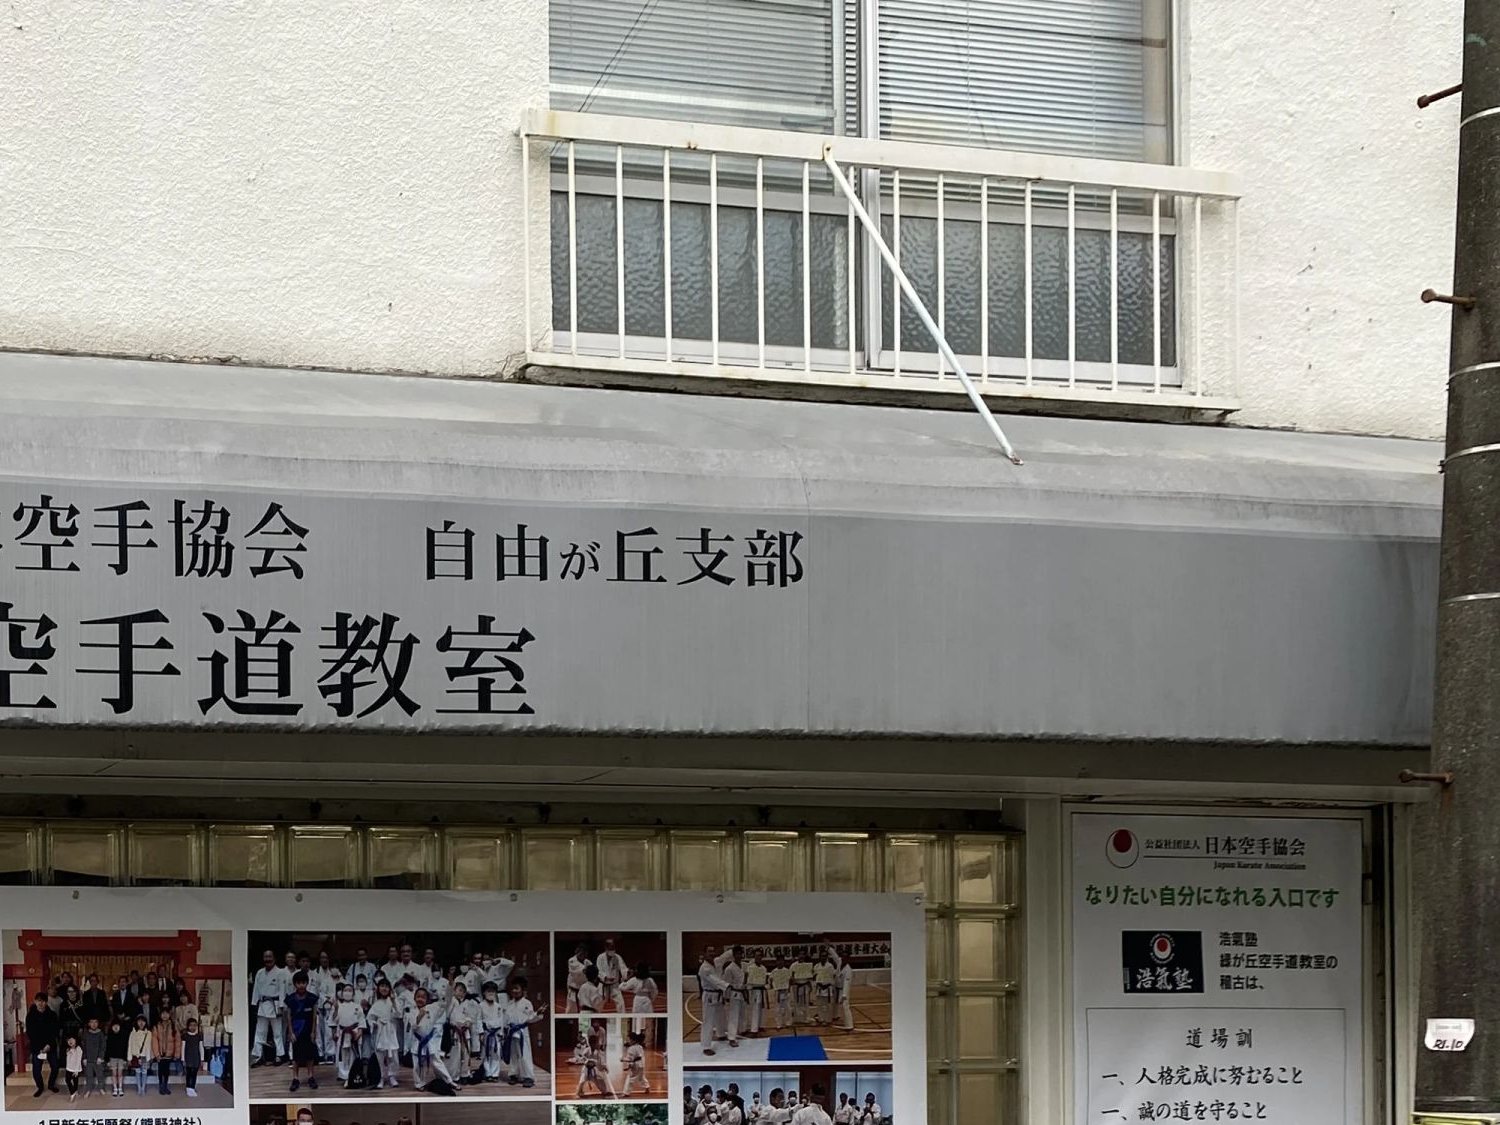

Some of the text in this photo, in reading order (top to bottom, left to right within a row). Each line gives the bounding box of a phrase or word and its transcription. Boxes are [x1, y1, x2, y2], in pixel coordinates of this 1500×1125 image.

[425, 519, 805, 590] 自由が丘支部
[1205, 836, 1306, 856] 日本空手協会
[1085, 884, 1339, 908] なりたい自分になれる入口です
[1219, 931, 1258, 947] 浩氣塾
[1219, 952, 1338, 970] 緑が丘空手道教室の
[1219, 975, 1265, 991] 稽古は、
[1185, 1028, 1253, 1049] 道場訓
[1101, 1065, 1303, 1086] 一、人格完成に努むること
[1101, 1101, 1267, 1121] 一、誠の道を守ること
